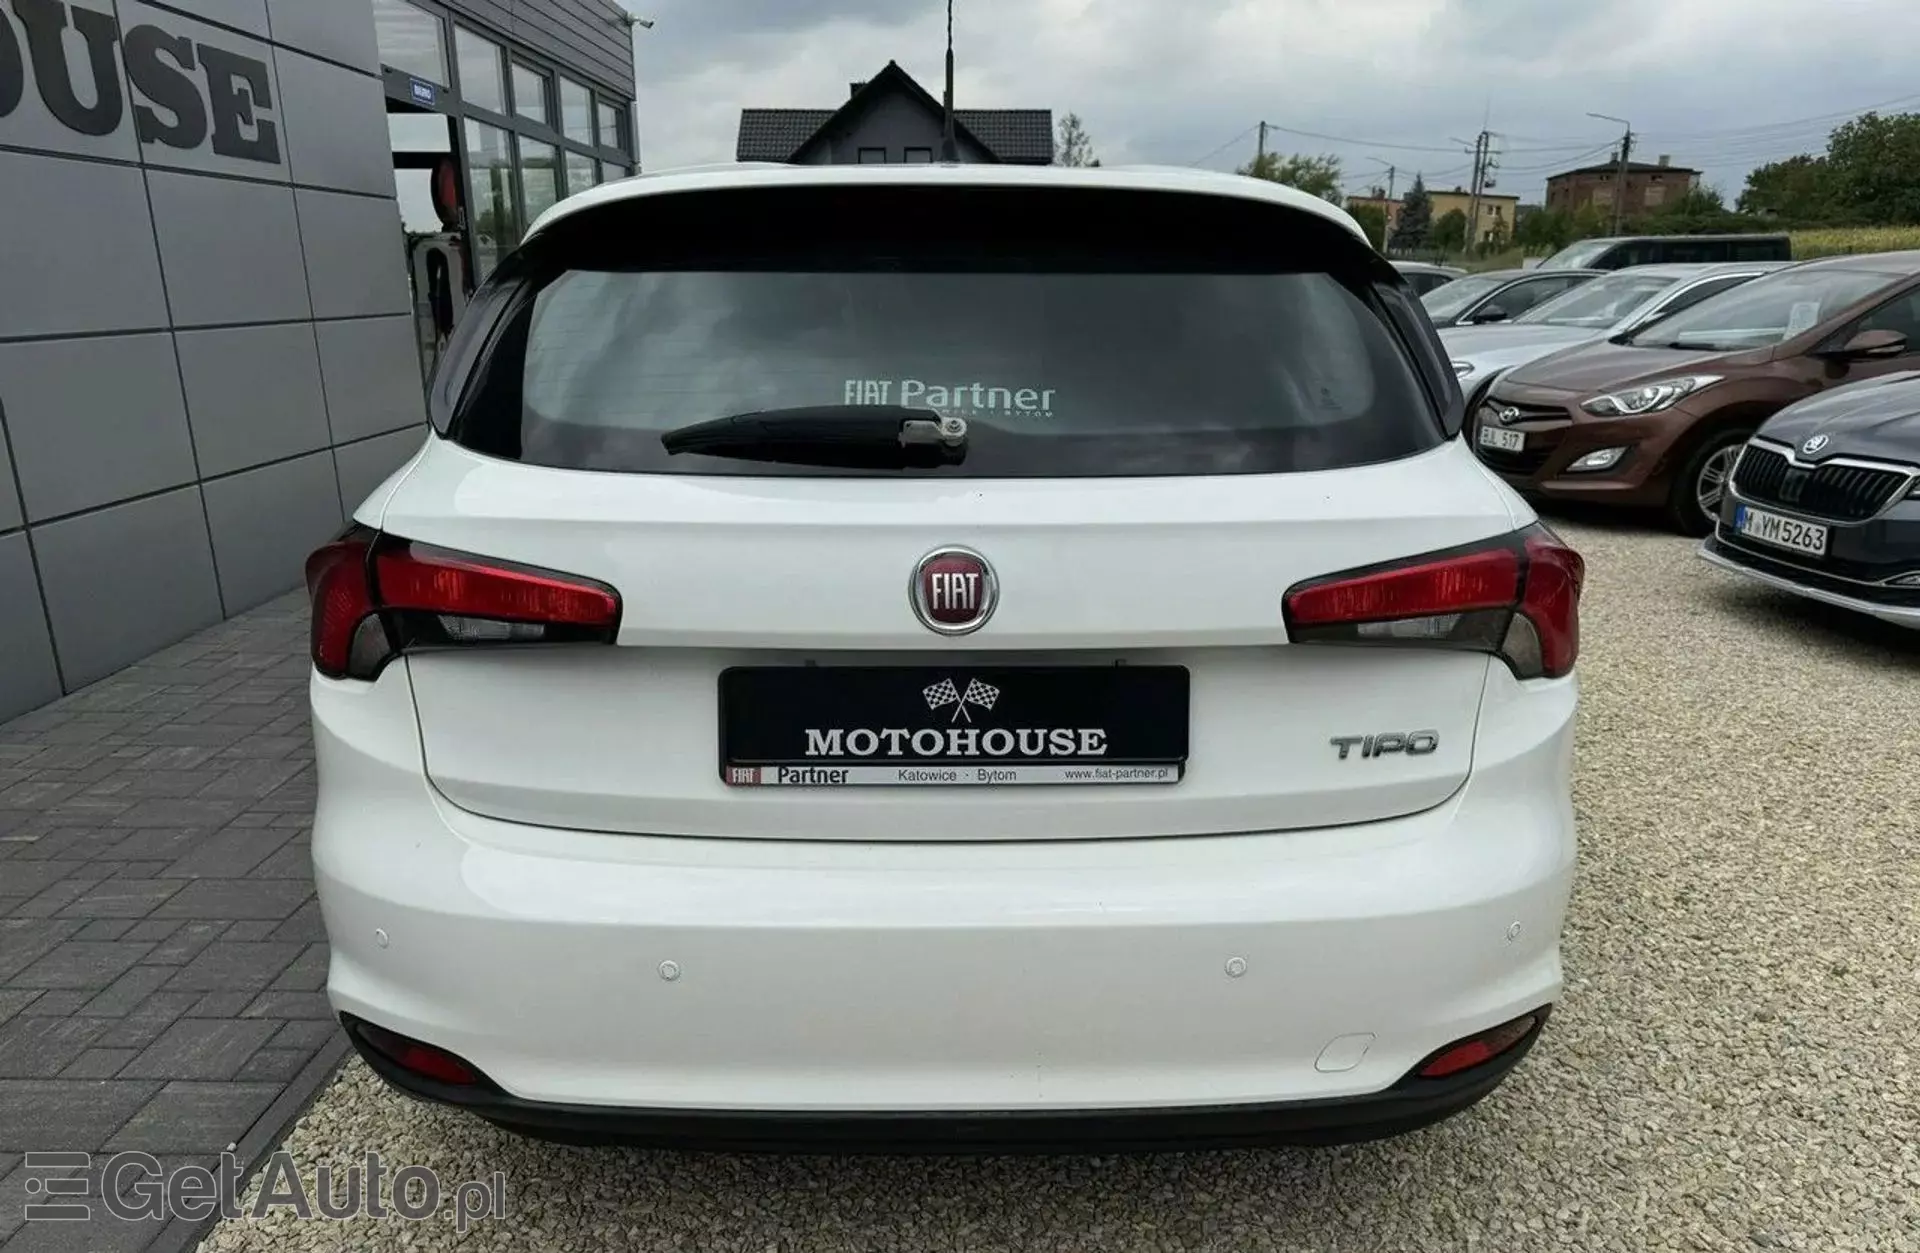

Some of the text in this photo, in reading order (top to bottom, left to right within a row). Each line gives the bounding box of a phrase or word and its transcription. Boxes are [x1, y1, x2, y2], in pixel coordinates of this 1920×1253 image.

[844, 379, 1056, 411] FIAT Partner
[931, 572, 979, 609] FIAT
[805, 728, 1108, 756] MOTOHOUSE
[1330, 729, 1440, 759] TIPO
[732, 766, 1169, 784] FIAT Partner Katowice Bytom www.fiat-partner.pl
